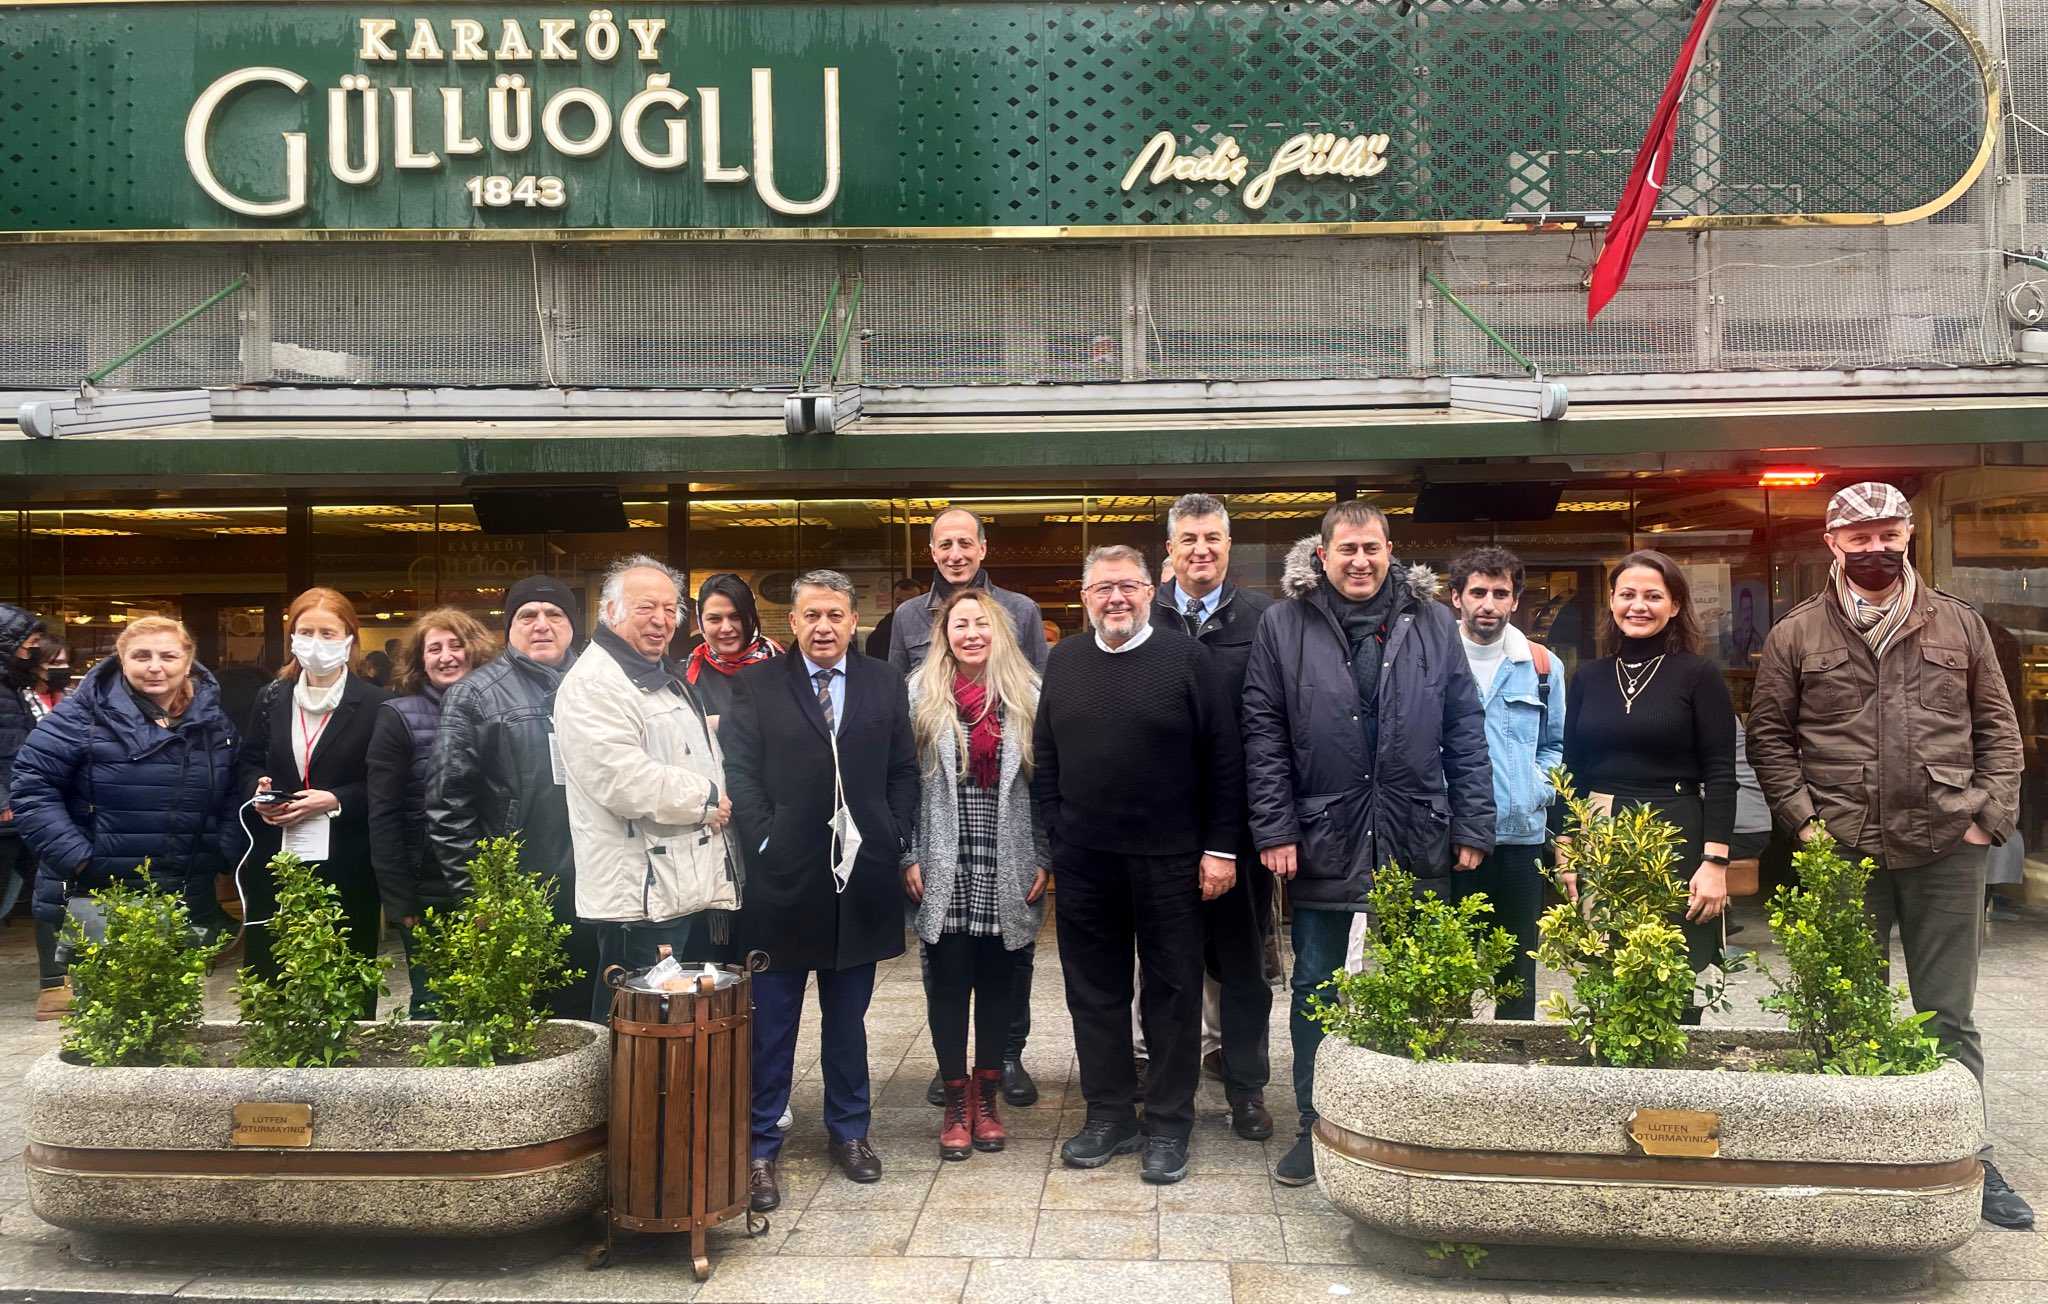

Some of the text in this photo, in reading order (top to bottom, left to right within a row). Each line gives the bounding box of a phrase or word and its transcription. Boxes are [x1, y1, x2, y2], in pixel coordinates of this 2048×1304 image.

[359, 9, 666, 61] KARAKÖY
[184, 66, 841, 216] GÜLLÜOĞLU
[465, 175, 567, 208] 1843
[1634, 1132, 1710, 1144] OTURMAYINIZ
[1648, 1122, 1688, 1133] LÜTFEN
